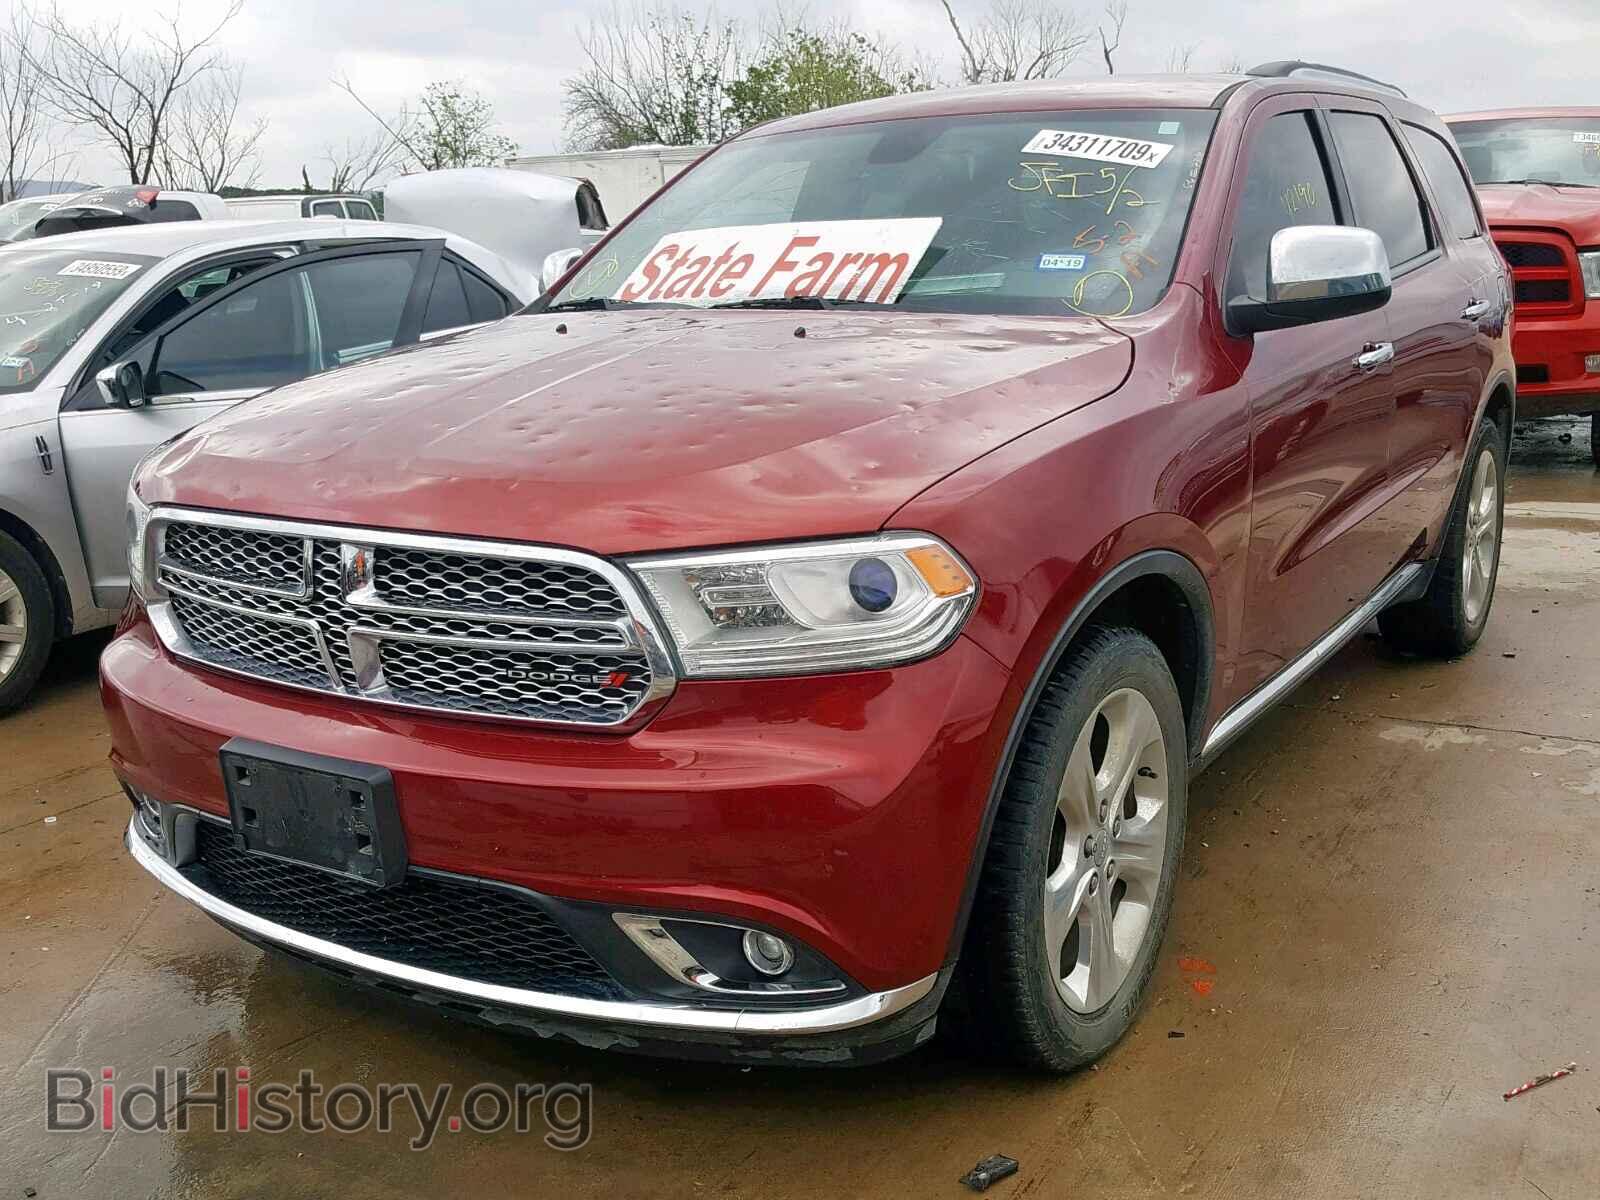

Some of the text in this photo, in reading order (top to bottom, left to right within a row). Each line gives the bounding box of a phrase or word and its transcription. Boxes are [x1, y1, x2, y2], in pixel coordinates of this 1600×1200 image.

[621, 236, 911, 304] State Farm
[507, 669, 612, 685] DODGE
